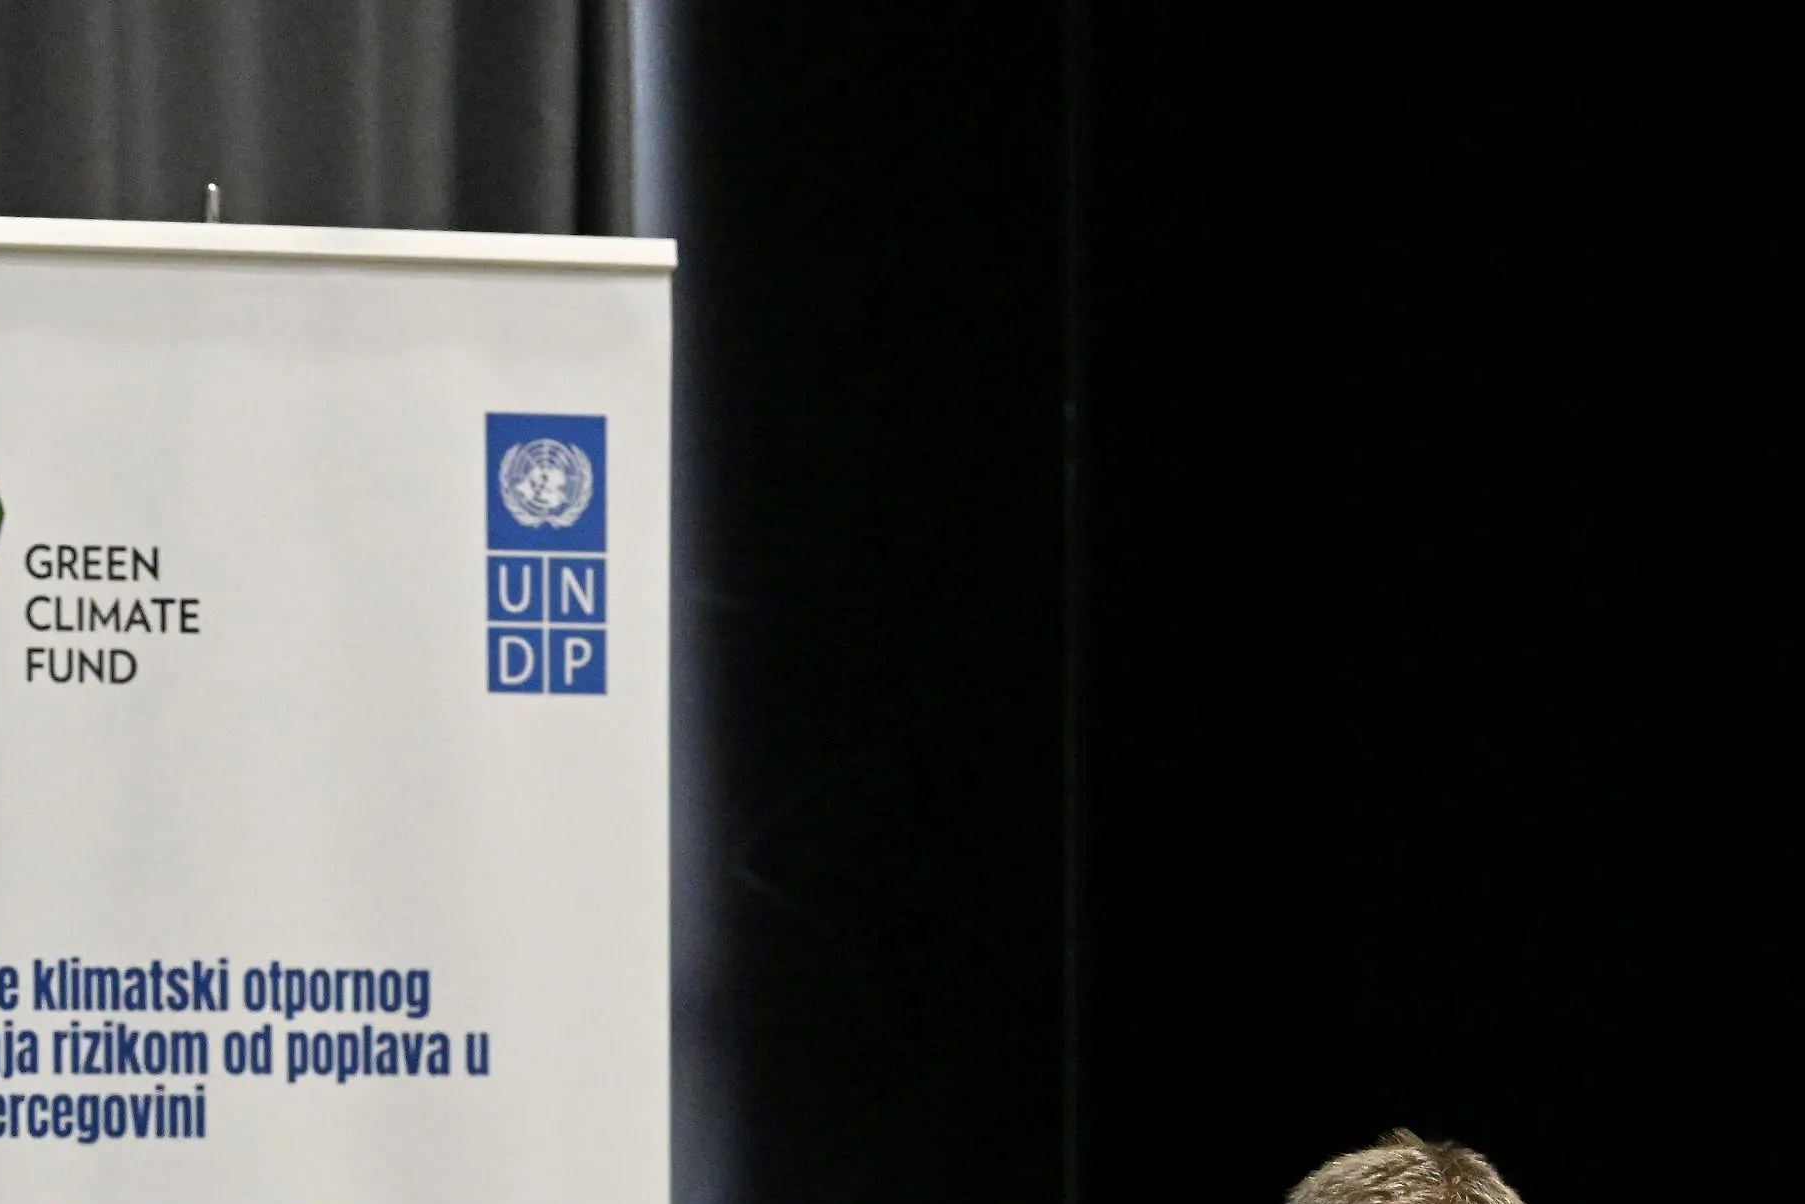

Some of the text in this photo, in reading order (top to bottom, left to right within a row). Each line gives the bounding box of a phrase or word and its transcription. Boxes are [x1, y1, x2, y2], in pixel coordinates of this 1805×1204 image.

[25, 543, 159, 582] GREEN
[25, 595, 200, 634] CLIMATE
[26, 647, 138, 685] FUND
[33, 956, 229, 1012] klimatski
[243, 962, 431, 1021] otpornog
[52, 1020, 209, 1076] rizikom
[223, 1024, 273, 1076] od
[287, 1024, 451, 1085] poplava
[465, 1032, 490, 1077] u
